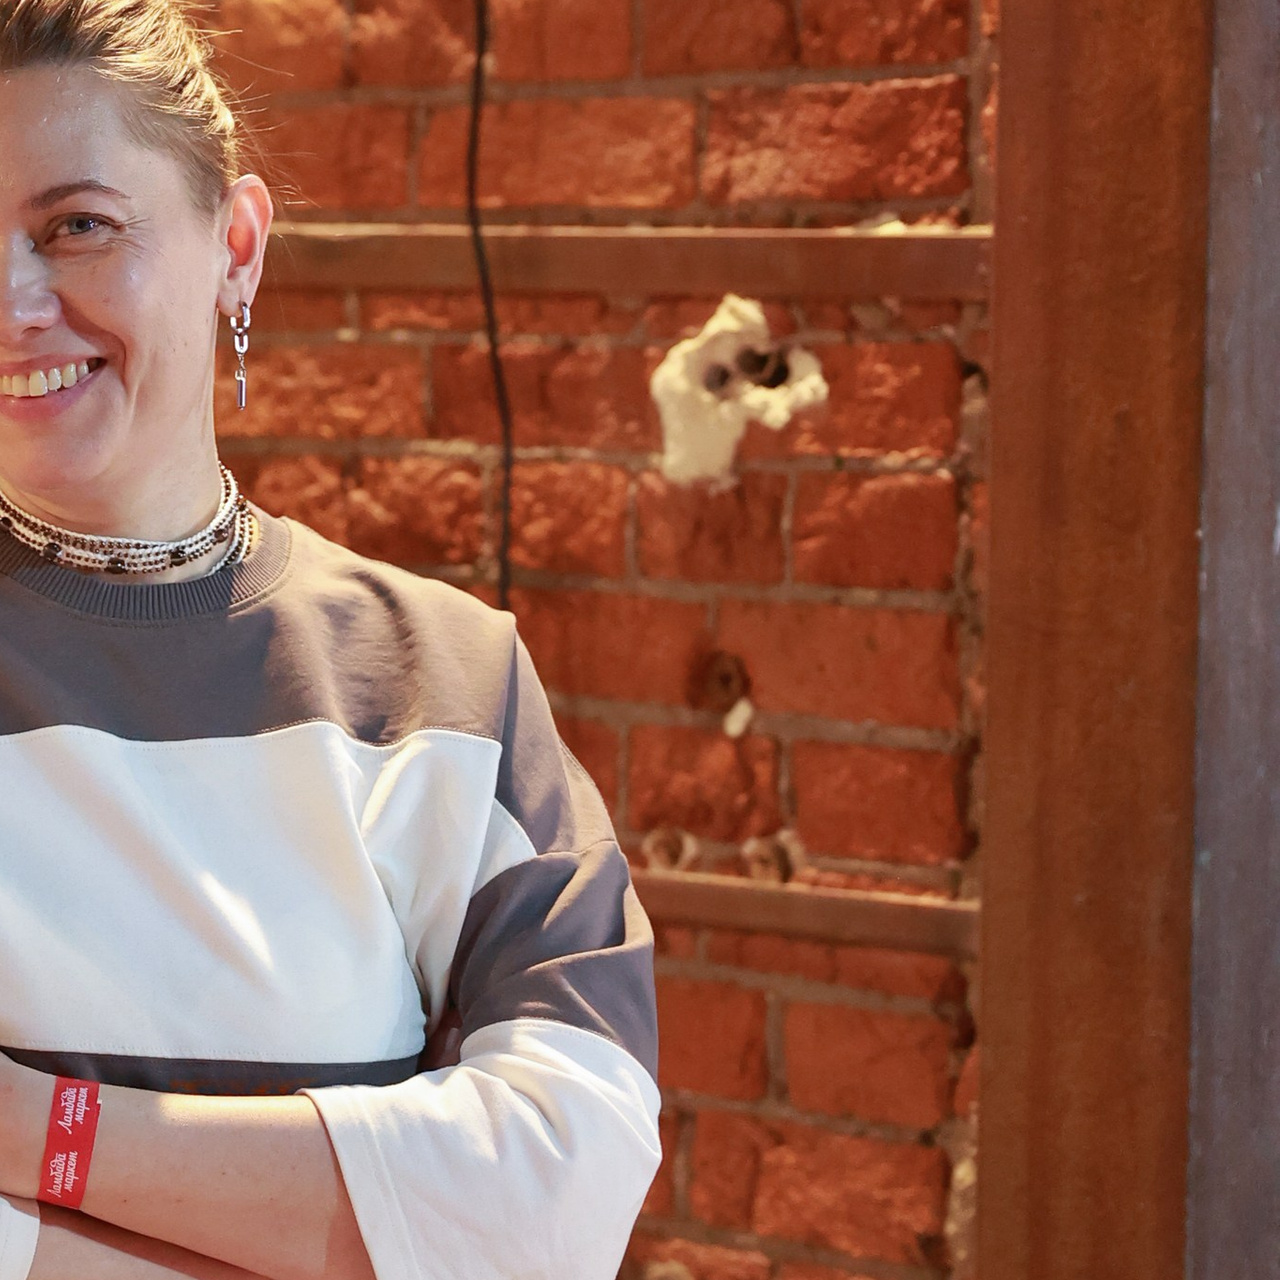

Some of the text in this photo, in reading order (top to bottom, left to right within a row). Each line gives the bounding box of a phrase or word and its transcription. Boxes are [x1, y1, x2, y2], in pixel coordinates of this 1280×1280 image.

[57, 1086, 78, 1135] Ламбада
[47, 1152, 67, 1198] Ламбада
[64, 1150, 80, 1193] маркет
